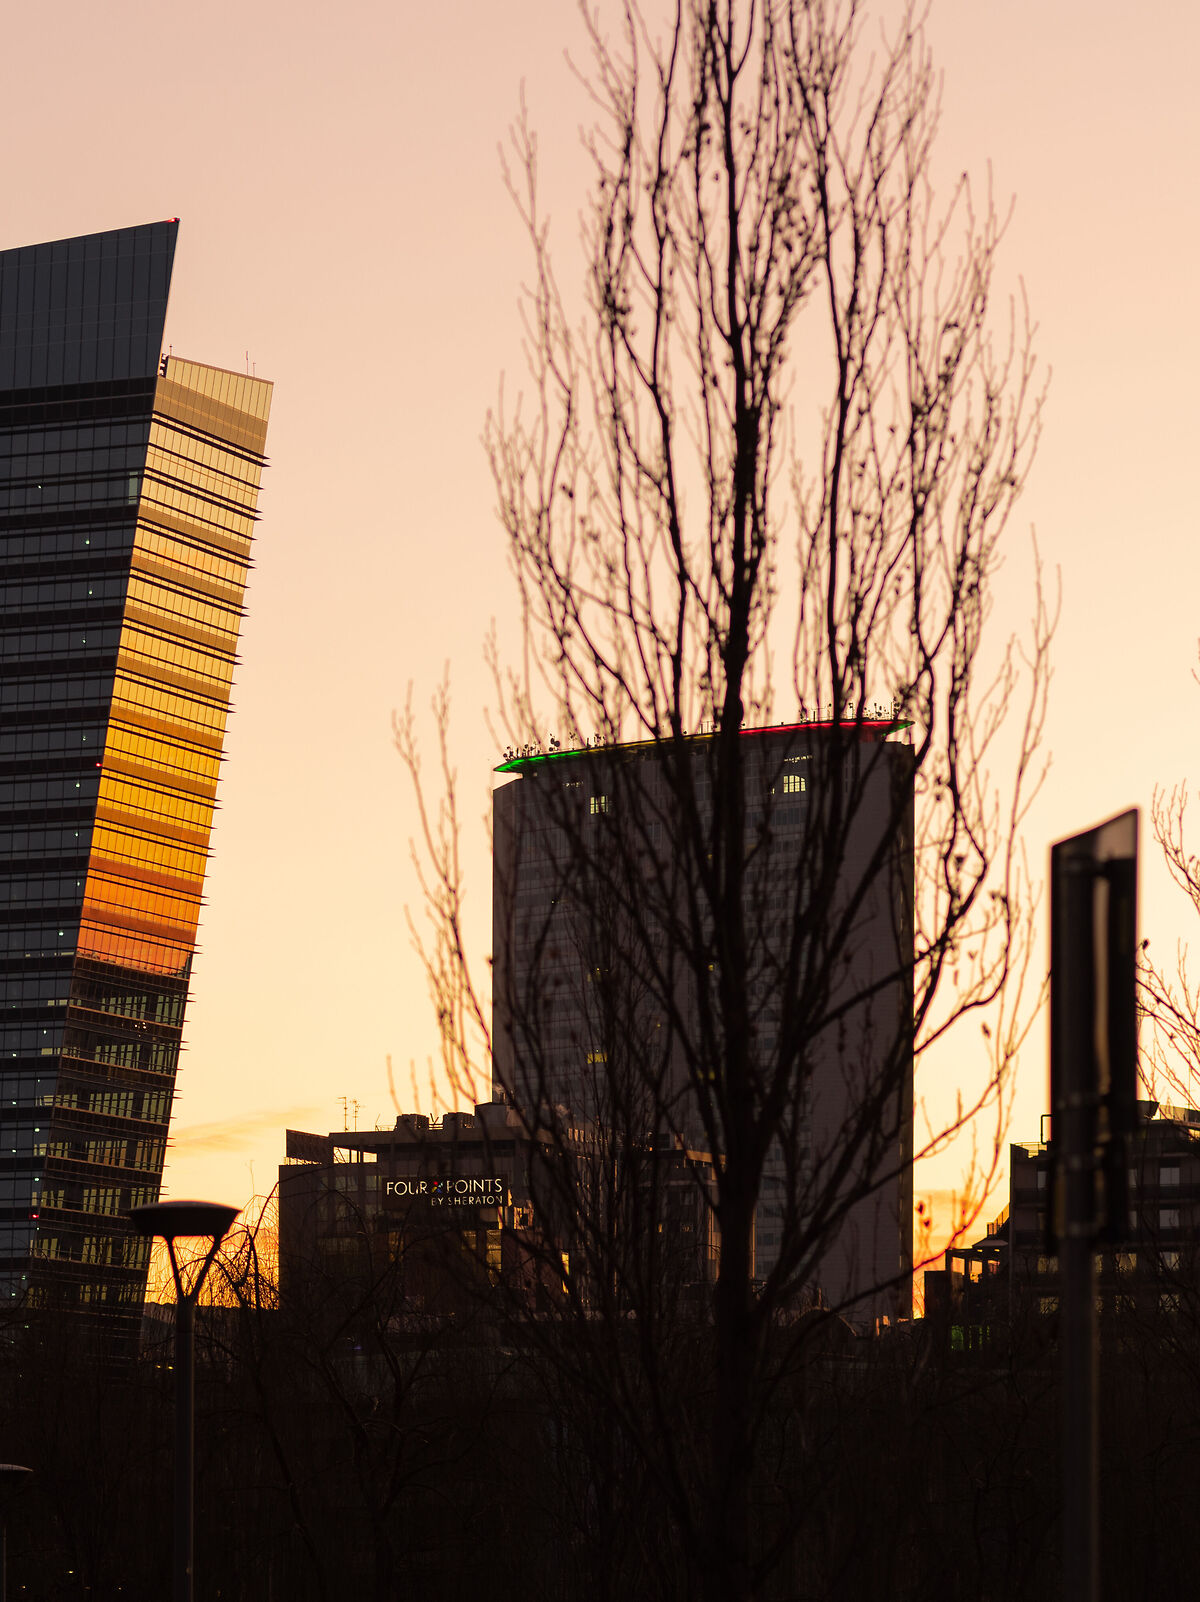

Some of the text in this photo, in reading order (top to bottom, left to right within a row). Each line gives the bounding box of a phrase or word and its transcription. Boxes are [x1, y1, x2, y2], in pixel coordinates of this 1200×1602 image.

[386, 1178, 503, 1196] FOUR POINTS
[431, 1195, 503, 1207] BY SHERATON
